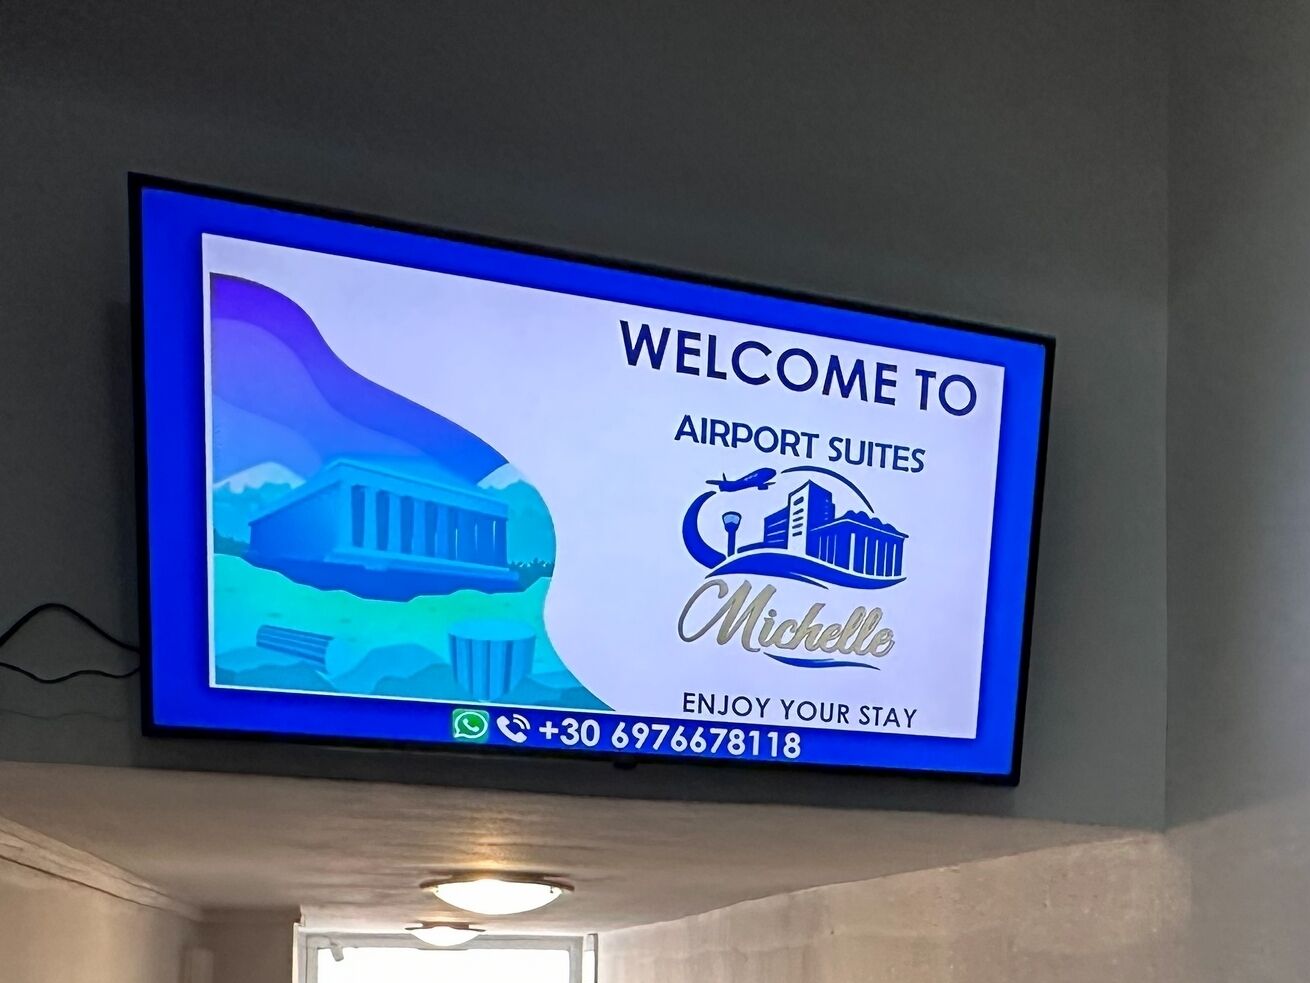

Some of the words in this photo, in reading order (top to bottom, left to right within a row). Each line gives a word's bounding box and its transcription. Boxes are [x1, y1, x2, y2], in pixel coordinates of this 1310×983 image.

[619, 320, 897, 406] WELCOME
[915, 368, 977, 416] TO
[674, 414, 820, 458] AIRPORT
[828, 435, 926, 474] SUITES
[678, 579, 895, 658] Michelle
[539, 717, 601, 747] +30
[611, 721, 802, 760] 6976678118
[682, 692, 770, 720] ENJOY
[779, 699, 850, 725] YOUR
[860, 705, 918, 729] STAY
